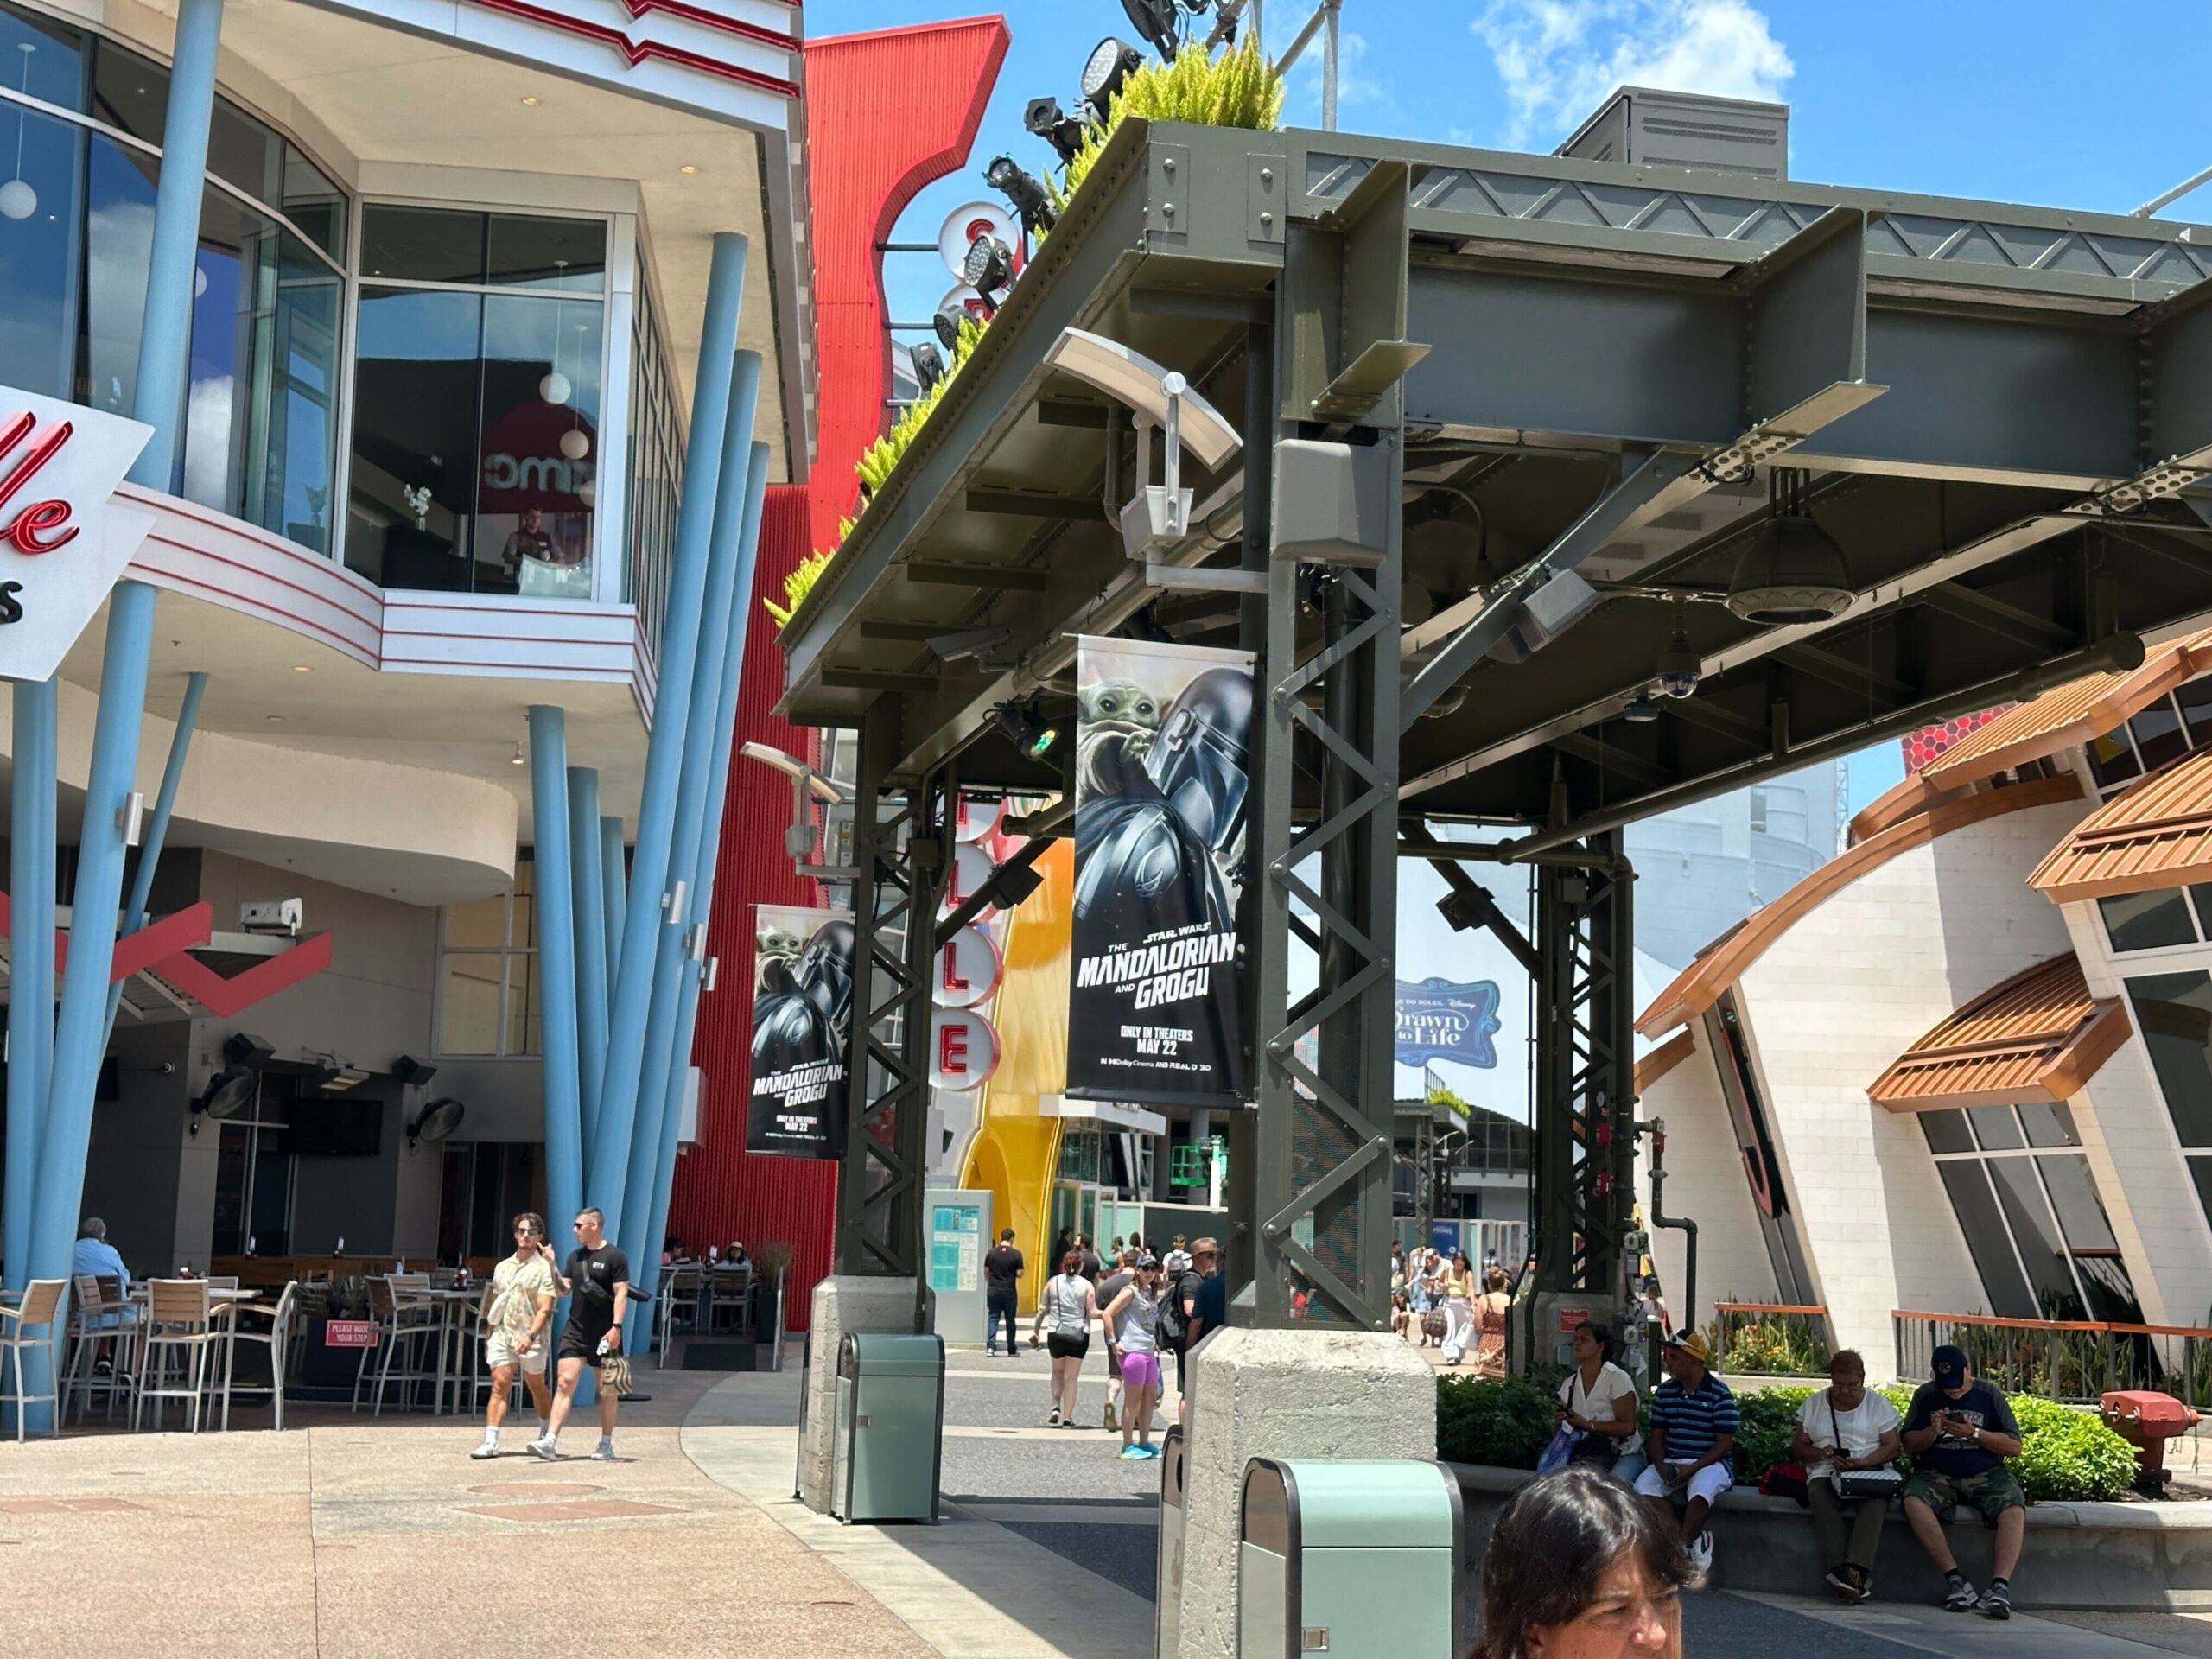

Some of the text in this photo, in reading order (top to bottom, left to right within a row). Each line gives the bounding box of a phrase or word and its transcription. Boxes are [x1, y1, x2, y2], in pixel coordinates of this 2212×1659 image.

[1143, 922, 1211, 944] STAR WARS
[1108, 943, 1128, 952] THE
[1077, 932, 1236, 988] MANDALORIAN
[1115, 967, 1210, 1009] AND GROGU
[1121, 1025, 1193, 1042] ONLY IN THEATERS
[1415, 1027, 1461, 1046] Life
[1137, 1039, 1177, 1055] MAY 22
[753, 1064, 843, 1096] MANDALORIAN
[784, 1084, 828, 1107] GROGU
[332, 1324, 370, 1333] PLEASE WATC
[336, 1333, 353, 1342] YOUR
